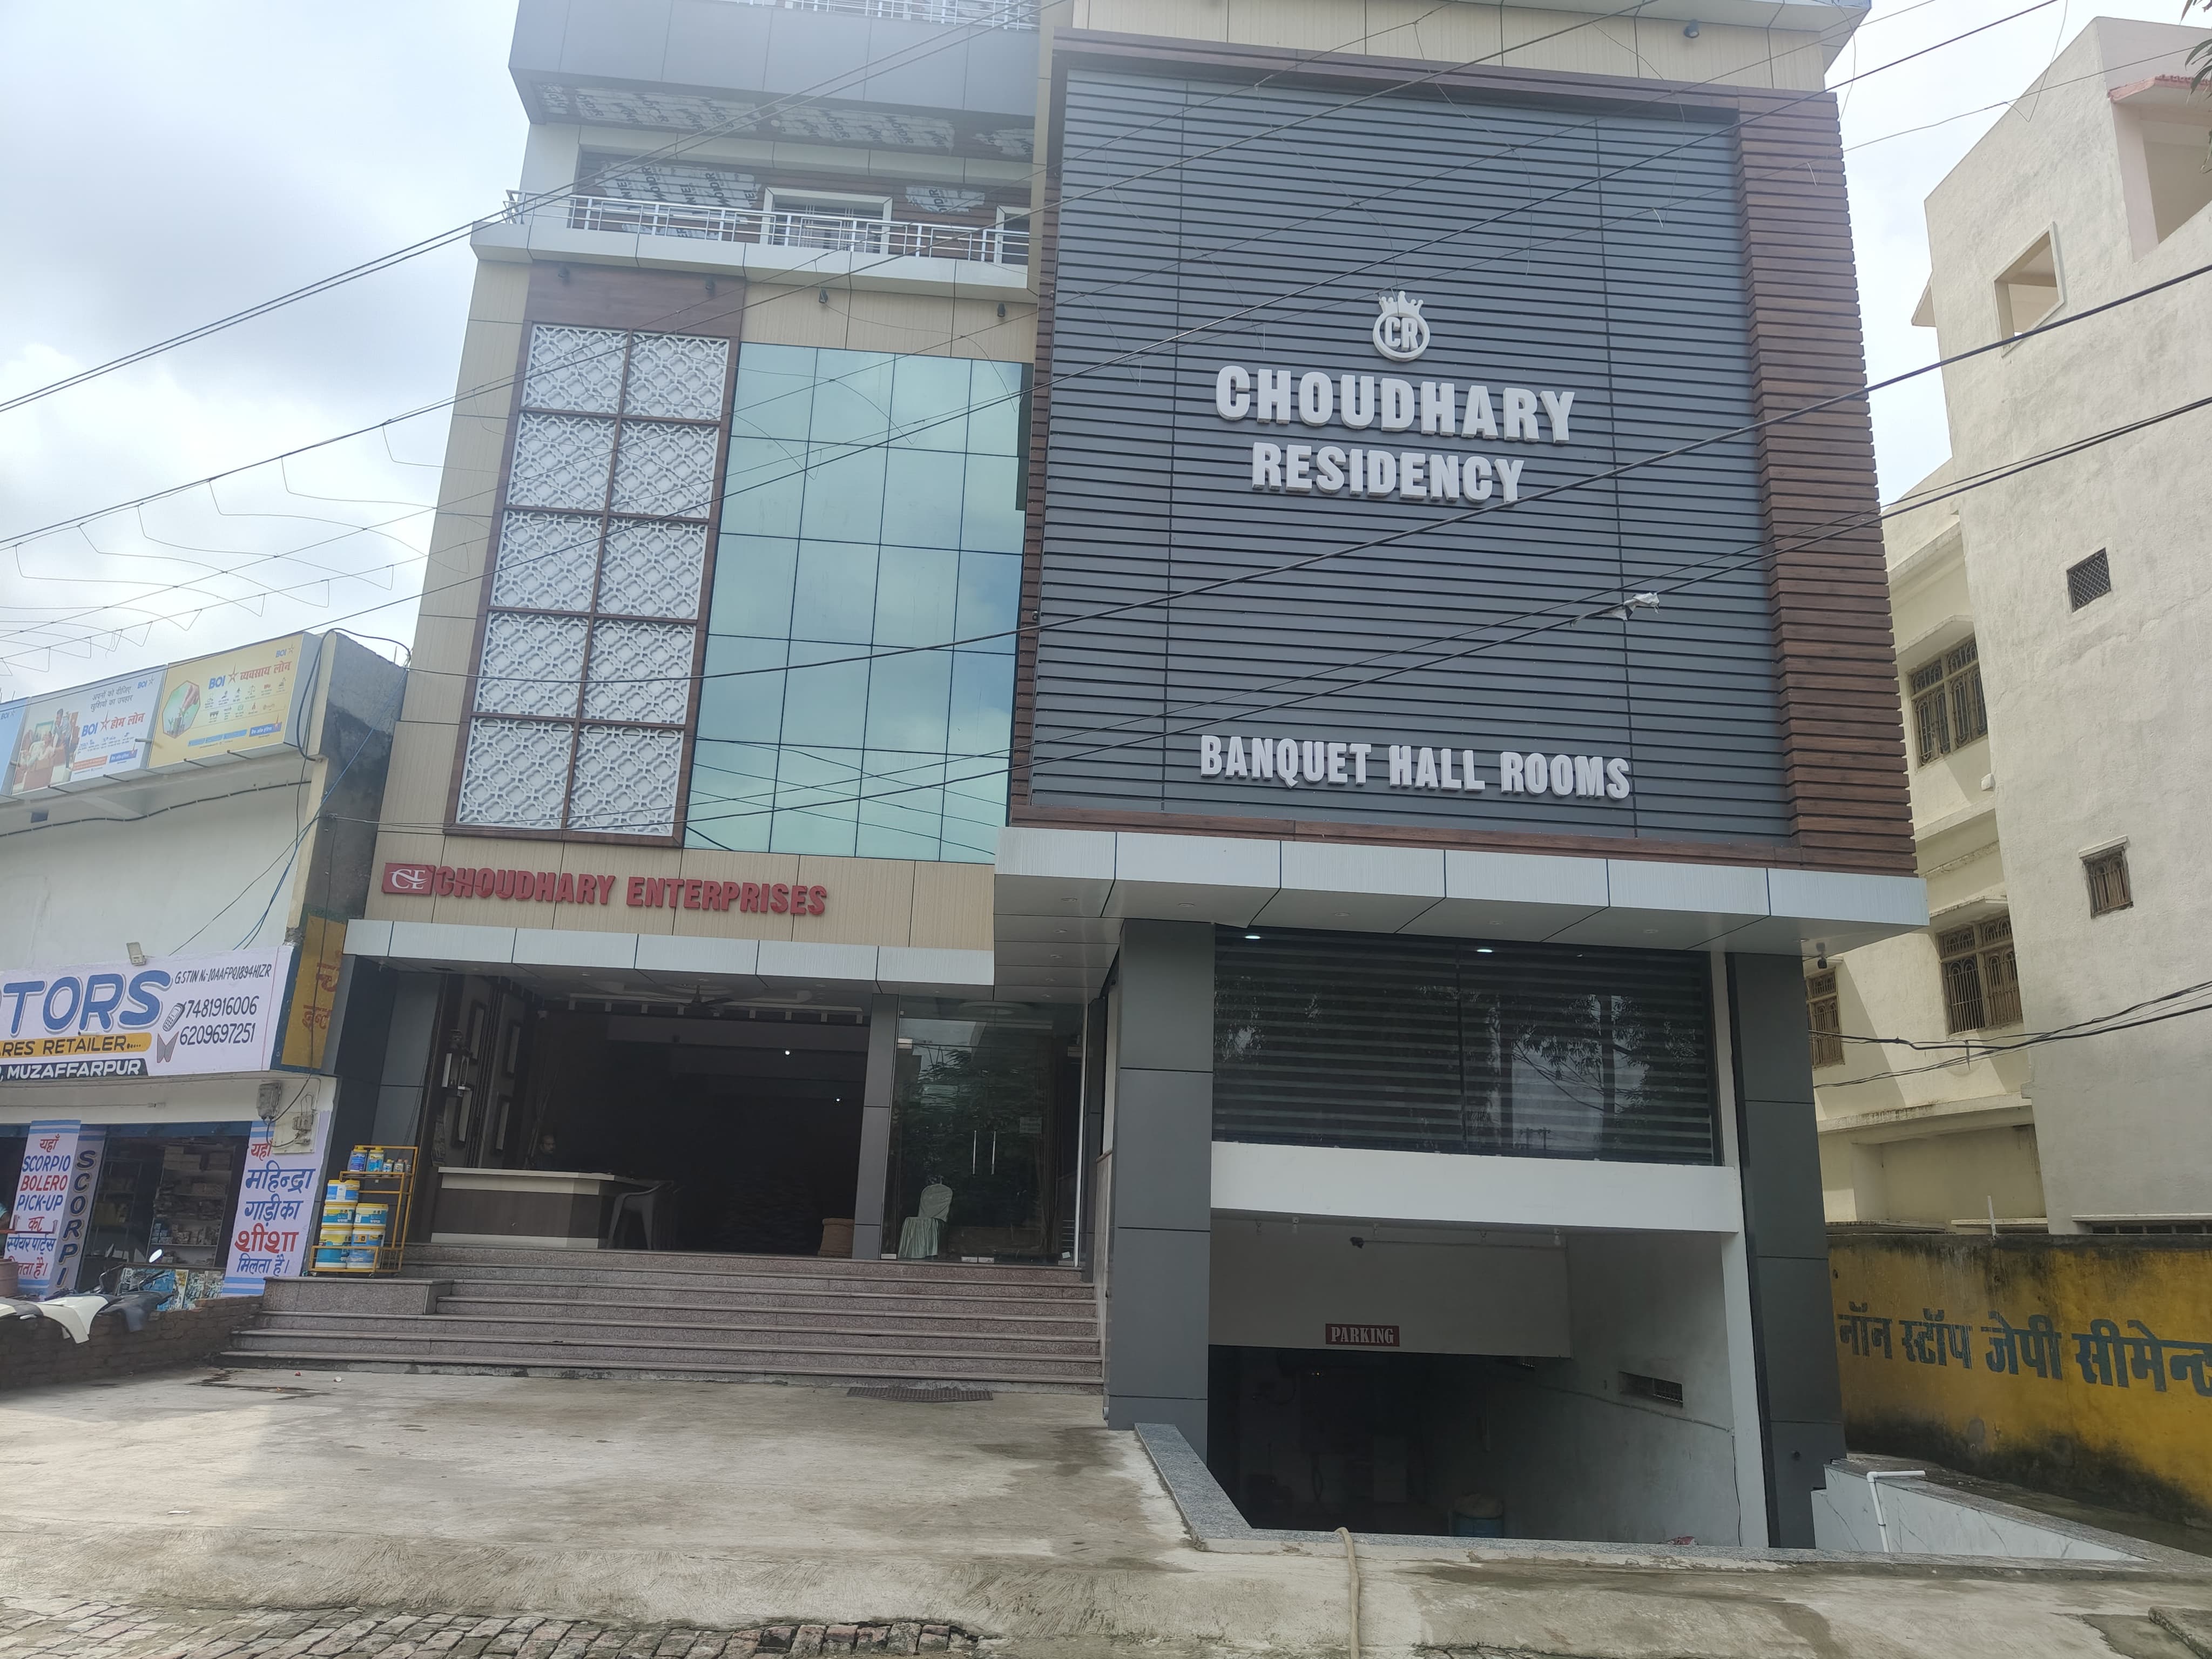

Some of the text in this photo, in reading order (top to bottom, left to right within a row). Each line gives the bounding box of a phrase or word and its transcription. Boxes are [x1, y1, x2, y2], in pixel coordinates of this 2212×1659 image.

[1385, 316, 1419, 352] CR
[1216, 366, 1575, 444] CHOUDHARY
[1252, 442, 1525, 504] RESIDENCY
[275, 649, 287, 658] BOI
[137, 680, 148, 689] BOI
[208, 660, 292, 690] BOI व्यवसाय लोन
[81, 712, 146, 737] BOI होम लोन
[1201, 734, 1630, 800] BANQUET HALL ROOMS
[434, 866, 616, 905] CHOUDHARY
[626, 876, 827, 916] ENTERPRISES
[174, 970, 199, 984] GSTIN
[0, 970, 171, 1037] TORS
[186, 995, 259, 1018] 7481916006
[180, 1022, 256, 1046] 6209697251
[0, 1041, 35, 1057] RES
[7, 1060, 141, 1080] MUZAFFARPUR
[39, 1134, 59, 1152] यहाँ
[22, 1155, 71, 1172] SCORPIO
[20, 1175, 68, 1191] BOLERO
[245, 1160, 316, 1193] महिन्द्रा
[16, 1195, 63, 1211] PICK-UP
[280, 1200, 304, 1220] का
[28, 1216, 45, 1231] का
[56, 1150, 96, 1287] SCORPI
[234, 1223, 299, 1254] शीशा
[237, 1253, 272, 1274] मिलता
[1331, 1327, 1394, 1344] PARKING
[1837, 1301, 1892, 1359] नॉन
[1899, 1308, 1973, 1370] स्टॉप
[1980, 1310, 2062, 1380] जेपी
